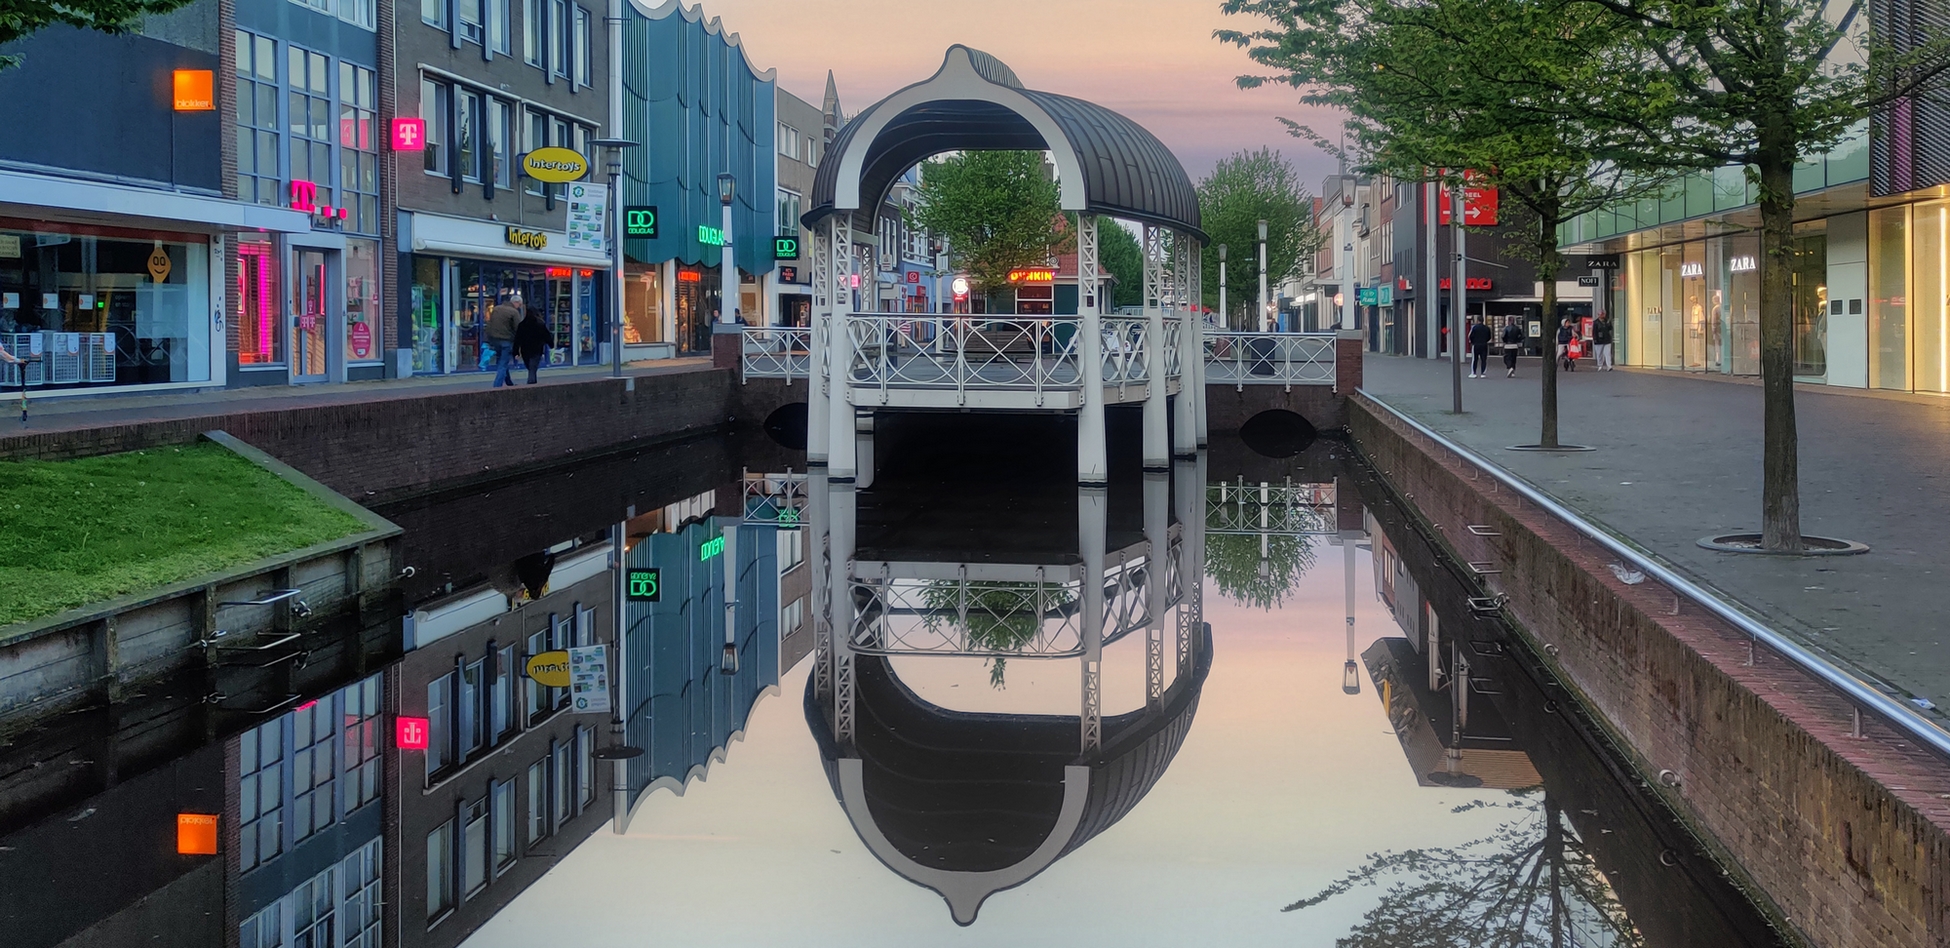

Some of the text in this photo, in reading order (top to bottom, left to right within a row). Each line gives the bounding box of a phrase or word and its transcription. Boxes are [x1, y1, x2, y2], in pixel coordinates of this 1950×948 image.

[529, 157, 581, 173] Intertoys
[628, 210, 655, 228] DO
[507, 226, 548, 250] Intertoys
[1681, 263, 1703, 276] ZARA
[1730, 256, 1756, 271] ZARA
